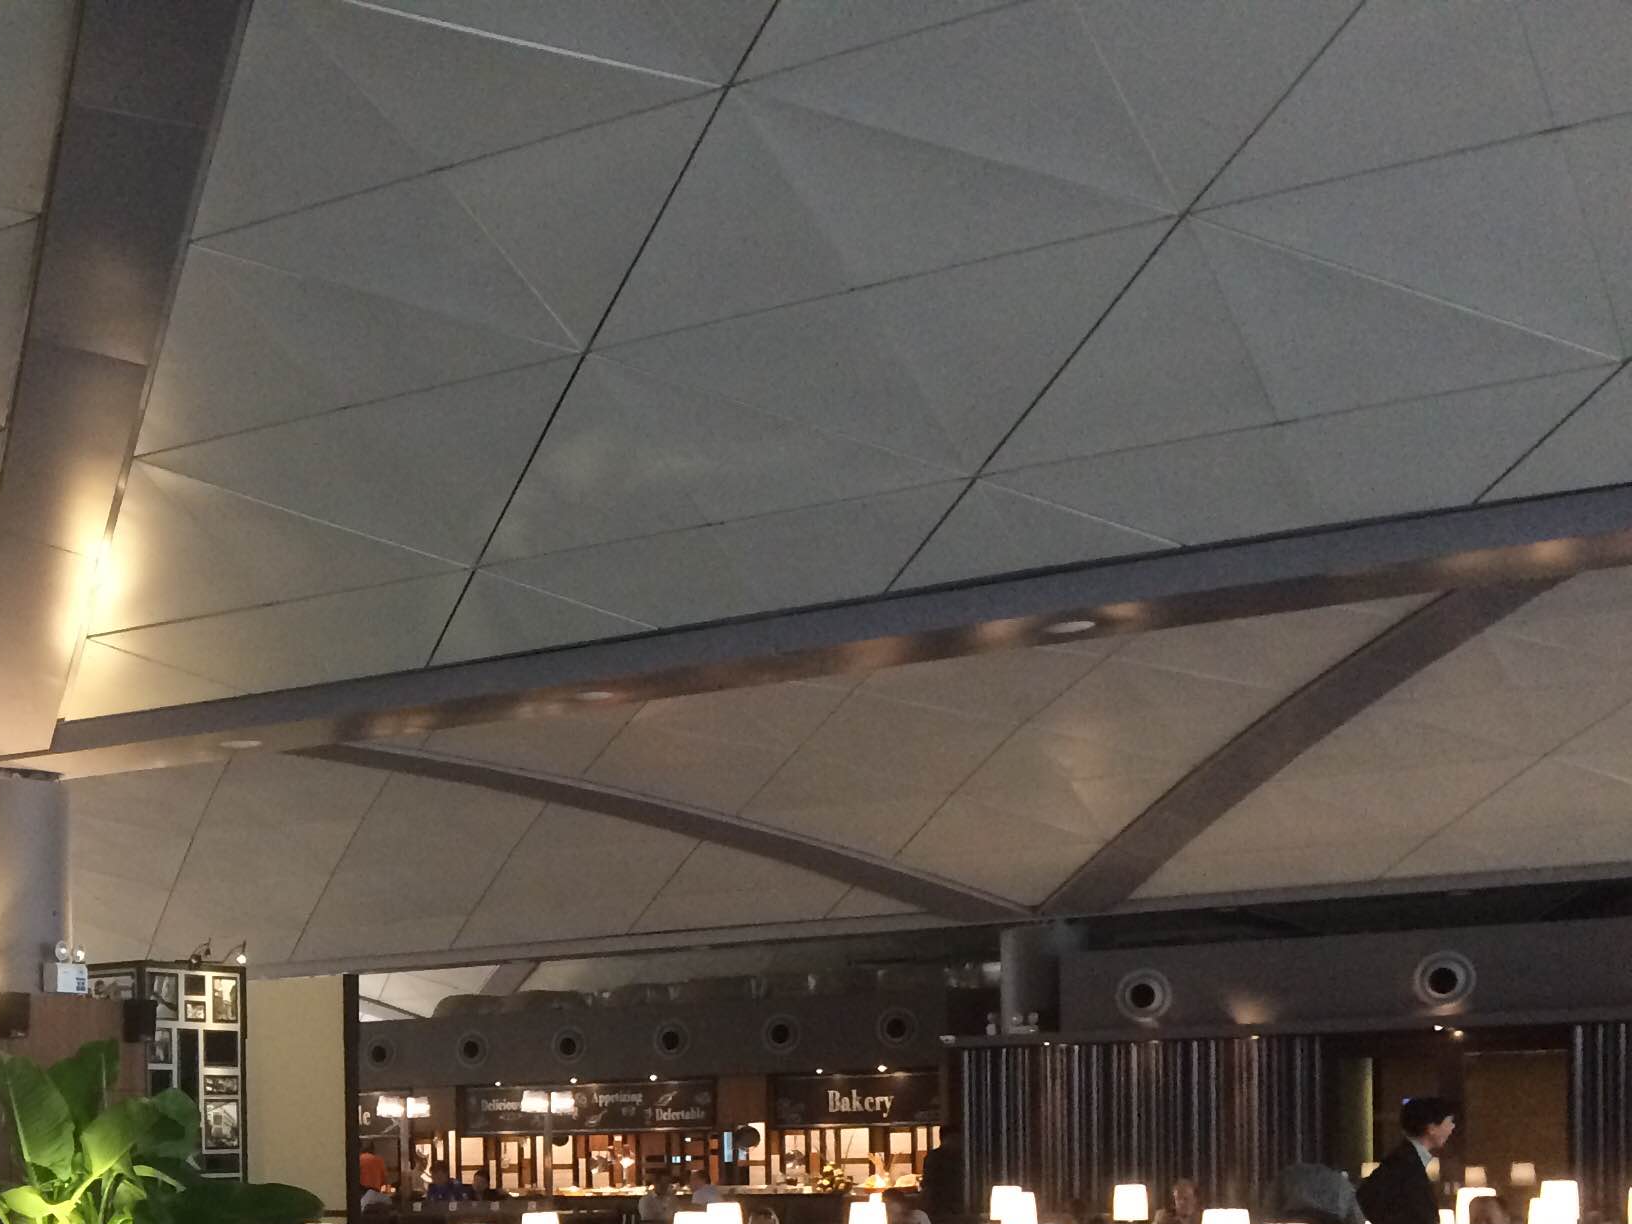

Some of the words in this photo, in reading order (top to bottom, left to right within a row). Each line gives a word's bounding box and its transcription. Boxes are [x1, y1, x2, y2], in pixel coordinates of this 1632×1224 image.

[480, 1098, 521, 1113] Deliciou
[827, 1088, 894, 1118] Bakery
[654, 1107, 706, 1122] Delectable
